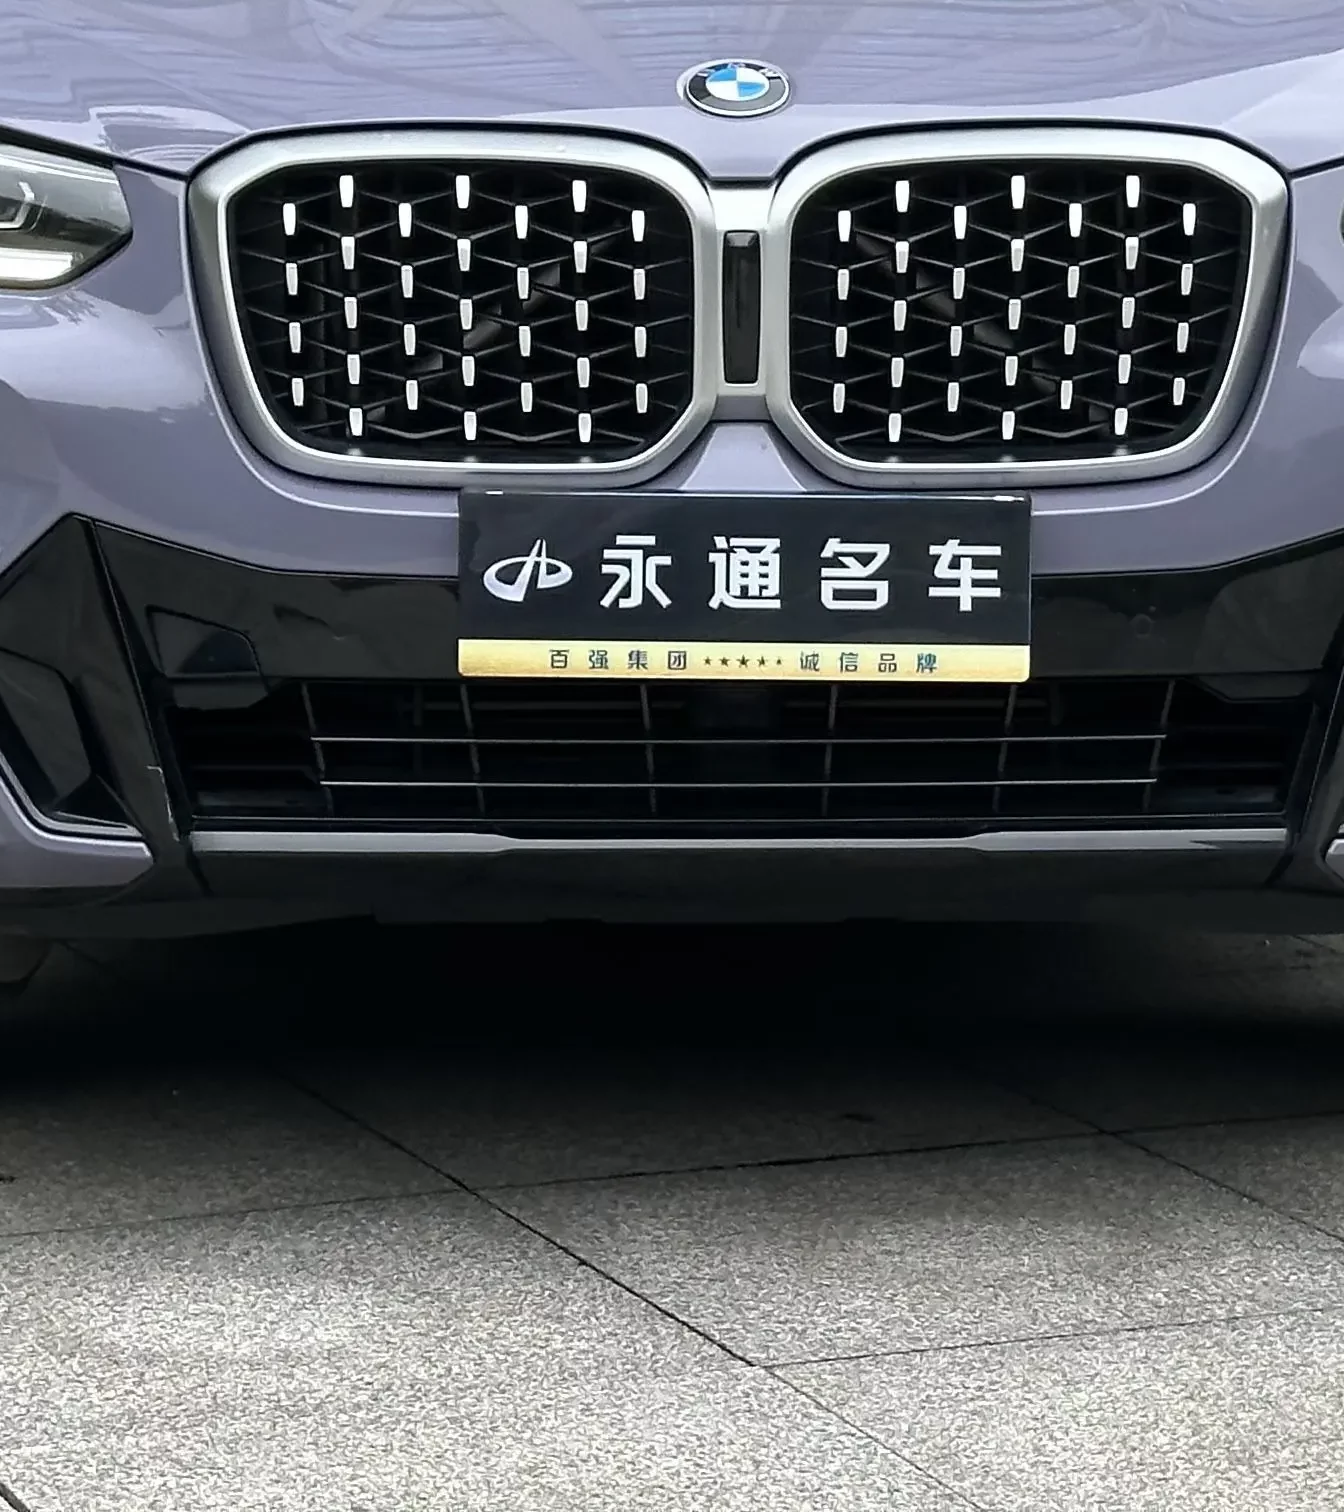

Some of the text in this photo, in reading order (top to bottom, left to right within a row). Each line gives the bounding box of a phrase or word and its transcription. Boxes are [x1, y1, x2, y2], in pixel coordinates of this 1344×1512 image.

[598, 534, 1003, 613] 永通名车
[548, 648, 939, 675] 百强集团 诚信品牌
